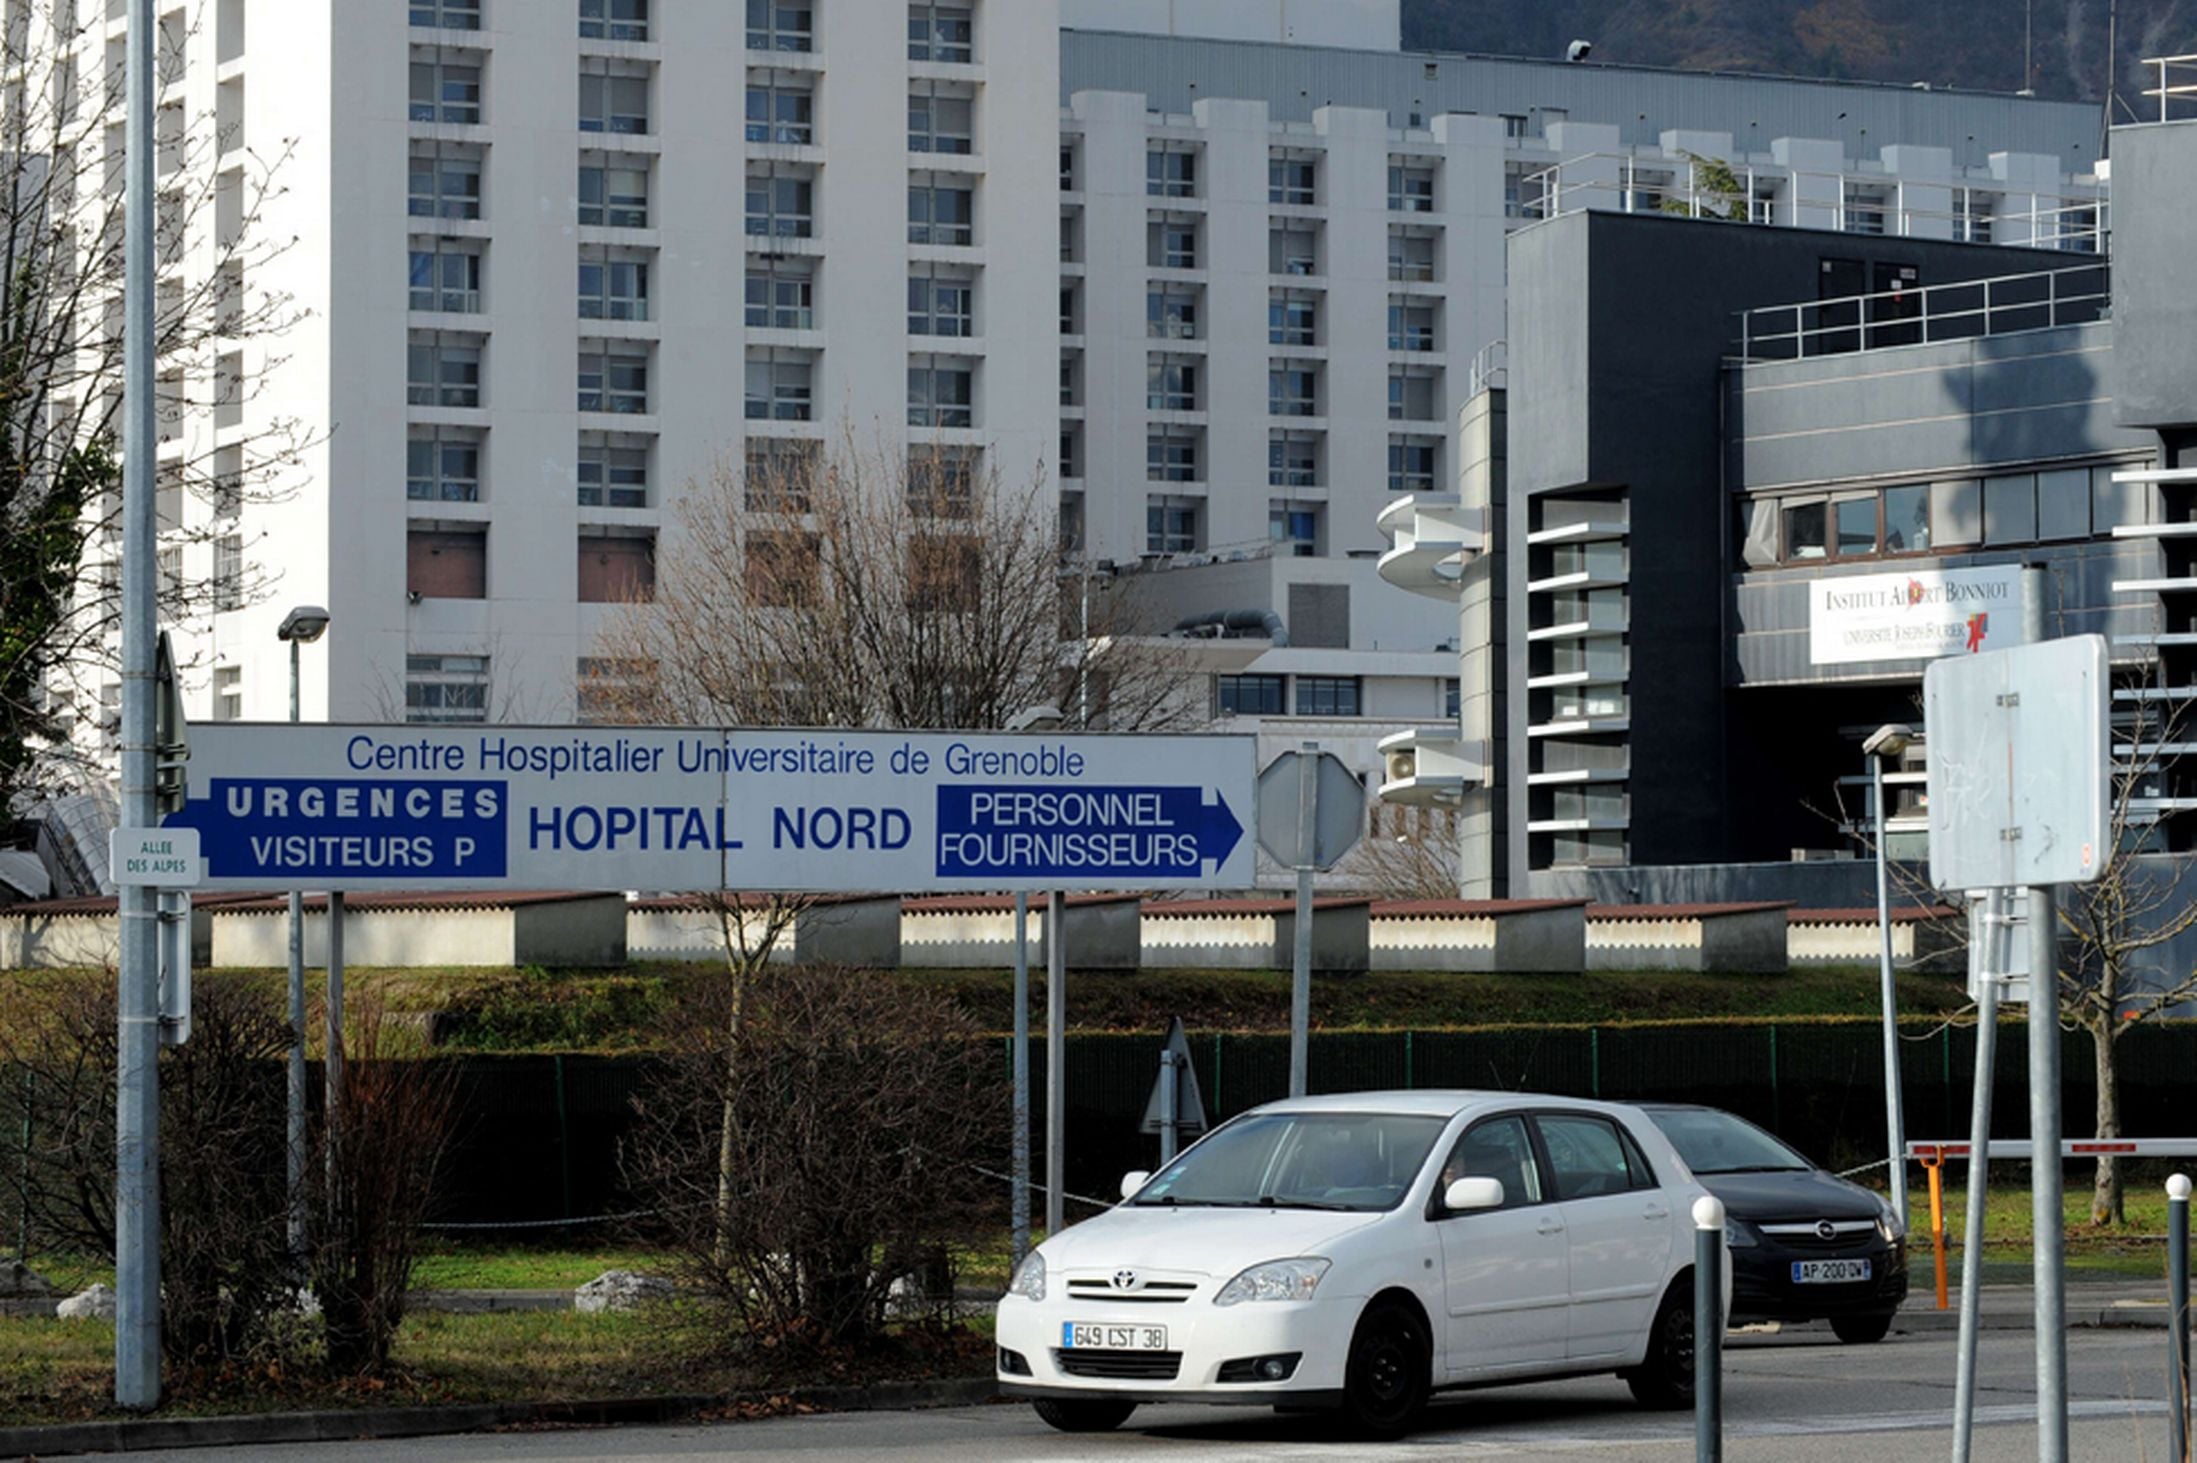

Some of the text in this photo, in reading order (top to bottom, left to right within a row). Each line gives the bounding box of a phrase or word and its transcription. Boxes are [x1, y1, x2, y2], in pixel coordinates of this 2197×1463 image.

[1945, 581, 2010, 603] BONNIOT
[347, 735, 1085, 779] Centre Hospitalier Universitaire de Grenoble
[226, 786, 499, 818] URGENCES
[971, 792, 1174, 826] PERSONNEL
[530, 805, 912, 850] HOPITAL NORD
[141, 841, 172, 854] ALLEE
[250, 836, 475, 866] VISITEURS P
[940, 834, 1199, 866] FOURNISSEURS
[127, 859, 186, 873] DES ALPES
[1075, 1326, 1162, 1348] 649 CST 38
